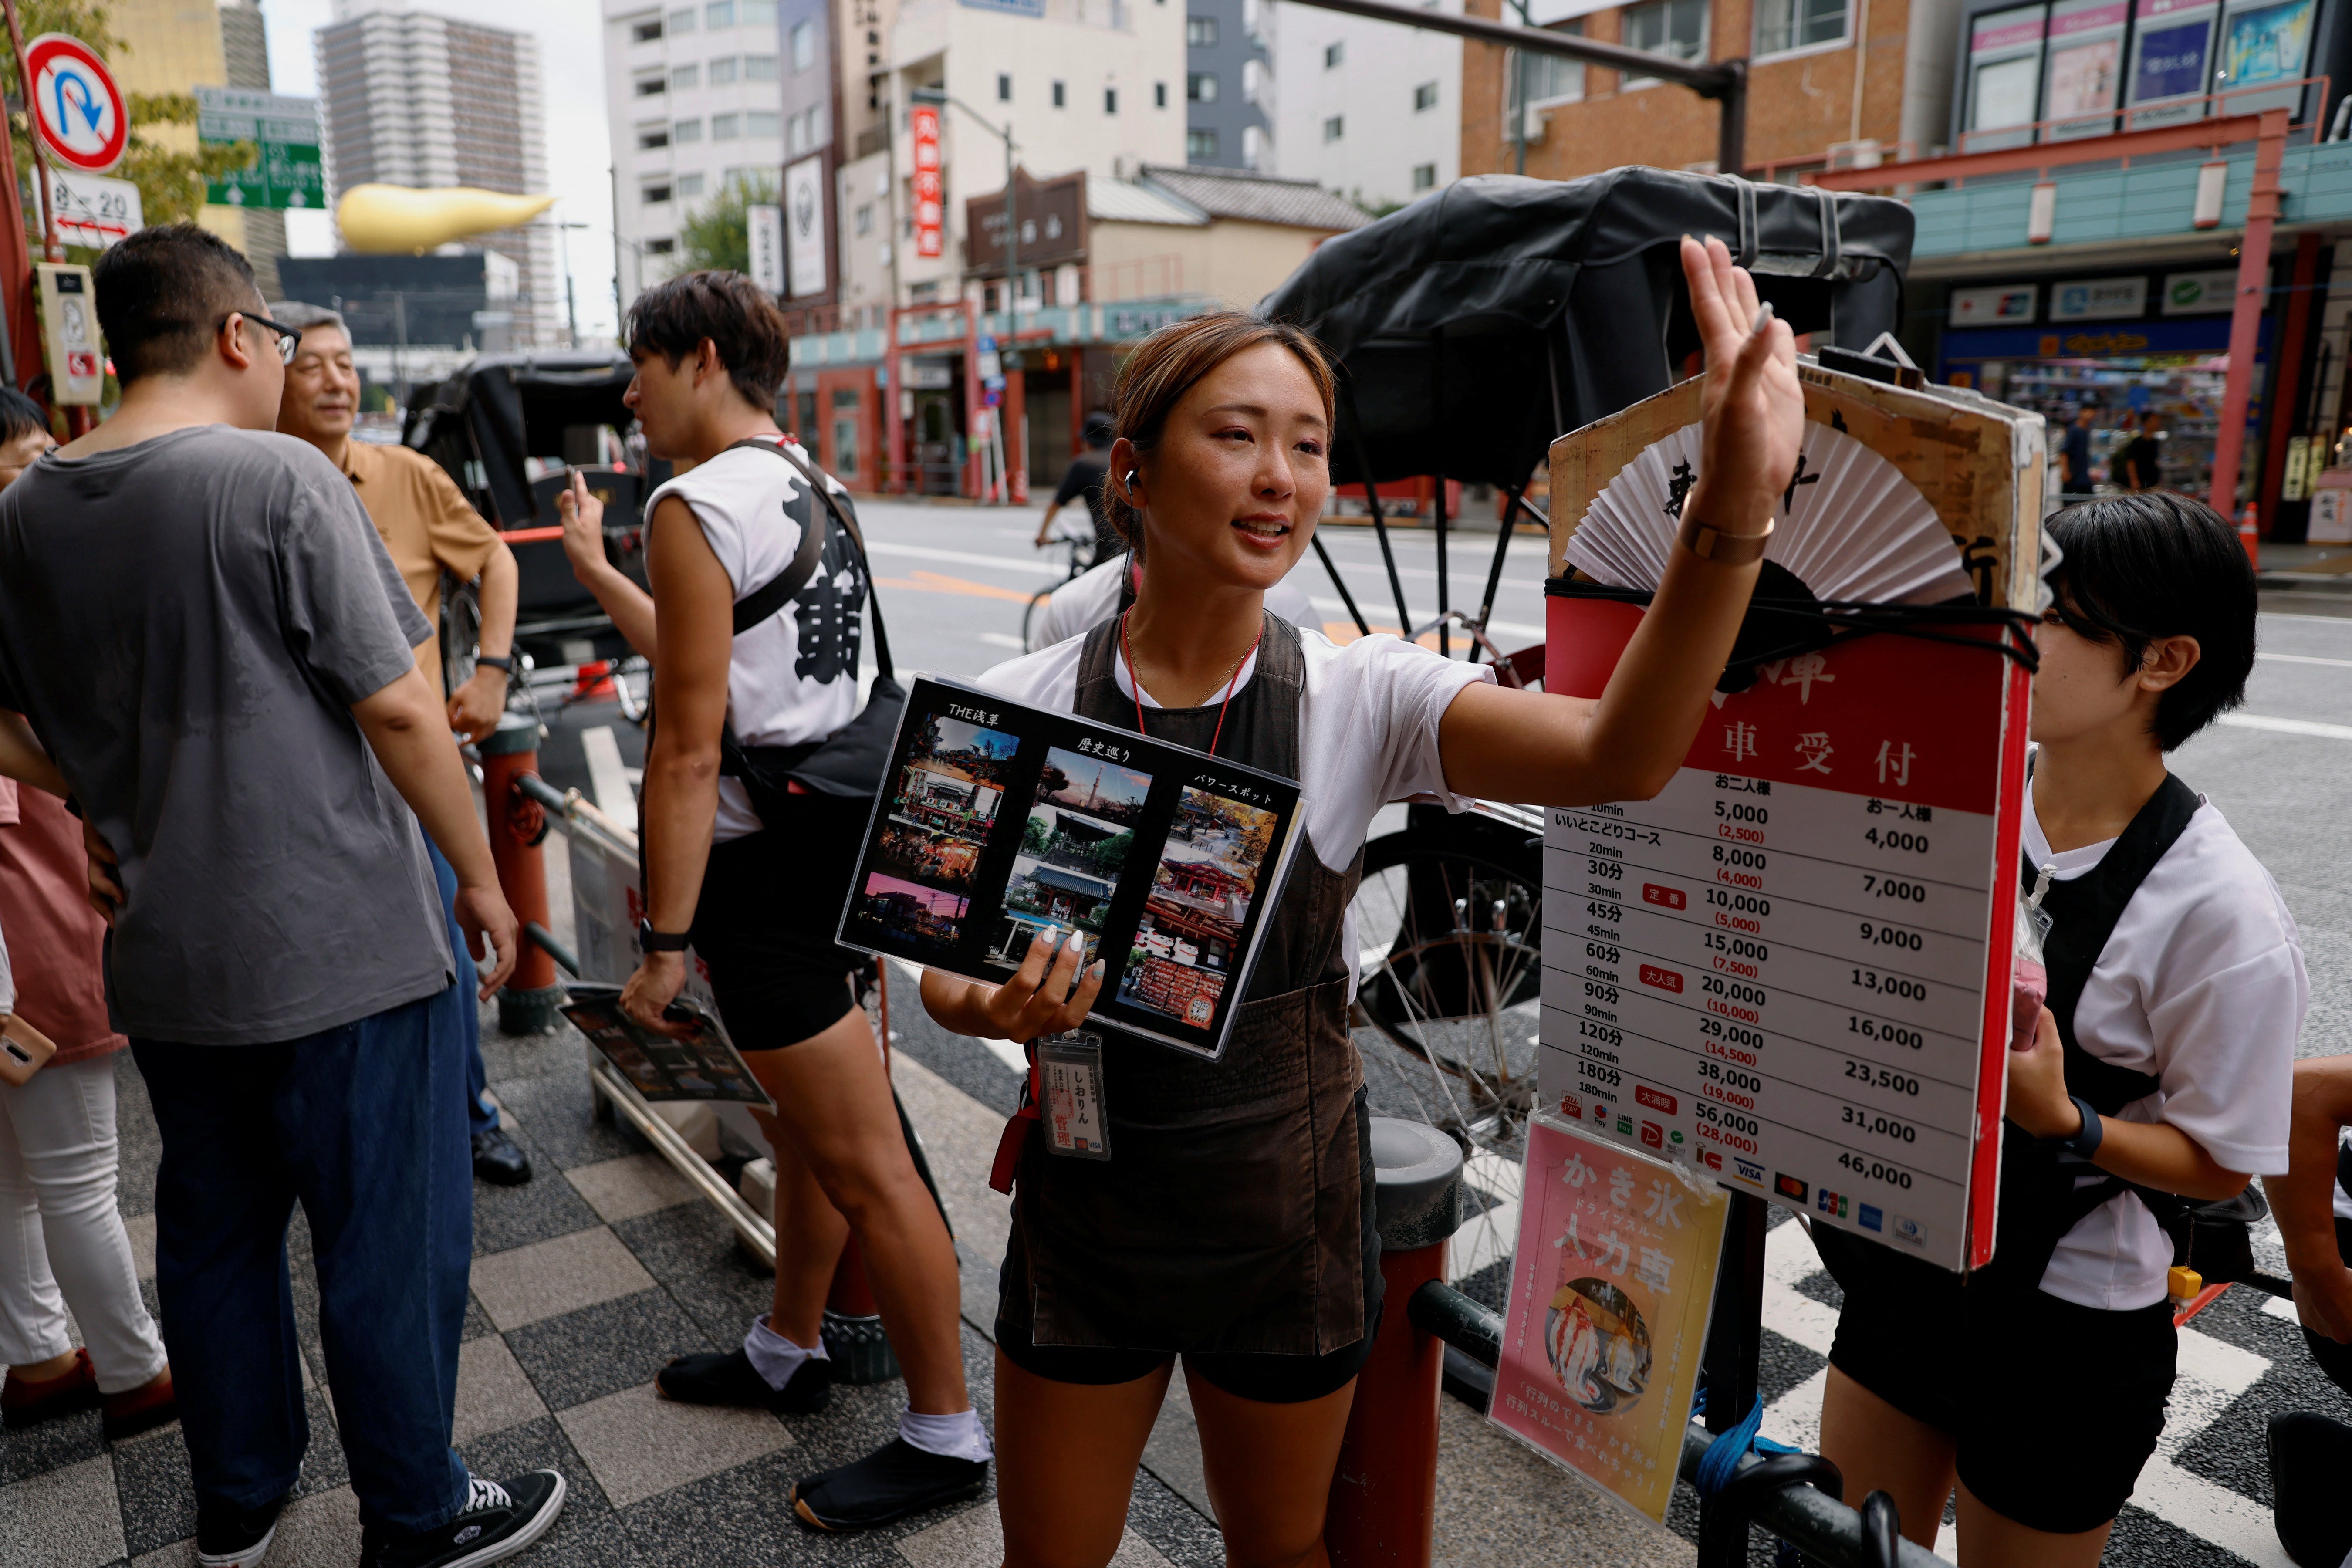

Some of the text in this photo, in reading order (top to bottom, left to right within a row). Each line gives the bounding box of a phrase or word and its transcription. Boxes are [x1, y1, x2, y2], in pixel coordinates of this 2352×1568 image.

[950, 703, 999, 726] THE浅草
[1077, 738, 1129, 762] 歴史巡り
[1194, 774, 1271, 804] パワースポット
[1716, 774, 1771, 796] お二人様
[1590, 804, 1623, 816] 10min
[1715, 801, 1768, 825] 5,000
[1867, 799, 1932, 822] お一人様
[1555, 814, 1661, 846] いいとこどりコース
[1719, 824, 1764, 844] (2,500)
[1865, 828, 1928, 853] 4,000
[1590, 842, 1622, 858] 20min
[1713, 845, 1766, 869] 8,000
[1588, 860, 1623, 880] 30分
[1717, 868, 1762, 889] (4,000)
[1588, 883, 1621, 900] 30min
[1649, 889, 1679, 906] 定番
[1864, 875, 1925, 902] 7,000
[1587, 902, 1622, 923] 45分
[1707, 888, 1770, 916] 10,000
[1587, 924, 1620, 942] 45min
[1715, 912, 1760, 934] (5,000)
[1705, 932, 1768, 961] 15,000
[1861, 923, 1922, 951] 9,000
[1586, 943, 1621, 964] 60分
[1586, 965, 1619, 983] 60min
[1713, 956, 1758, 978] (7,500)
[1646, 970, 1676, 989] 大人気
[1702, 976, 1765, 1006] 20,000
[1852, 969, 1925, 1001] 13,000
[1585, 982, 1619, 1004] 90分
[1585, 1004, 1617, 1023] 90min
[1707, 998, 1759, 1024] (10,000)
[1579, 1021, 1623, 1046] 120分
[1700, 1018, 1763, 1049] 29,000
[1849, 1016, 1923, 1049] 16,000
[1580, 1043, 1619, 1064] 120min
[1705, 1040, 1757, 1066] (14,500)
[1578, 1061, 1621, 1087] 180分
[1698, 1060, 1761, 1093] 38,000
[1845, 1061, 1919, 1096] 23,500
[1075, 1071, 1088, 1124] しおりん
[1564, 1095, 1580, 1105] au
[1579, 1081, 1617, 1103] 180min
[1642, 1091, 1671, 1110] 大満喫
[1703, 1083, 1754, 1110] (19,000)
[1565, 1105, 1578, 1114] PAY
[1618, 1113, 1632, 1124] LINE
[1696, 1102, 1758, 1136] 56,000
[1054, 1115, 1071, 1146] 管理
[1595, 1117, 1606, 1128] Pay
[1619, 1124, 1631, 1133] Pay
[1842, 1106, 1915, 1143] 31,000
[1089, 1141, 1102, 1149] VISA
[1697, 1122, 1758, 1154] (28,000)
[1737, 1164, 1761, 1181] VISA
[1838, 1152, 1912, 1190] 46,000
[1562, 1152, 1684, 1228] かき氷
[1576, 1198, 1663, 1240] ドライブスルー
[1553, 1213, 1675, 1294] 人力車
